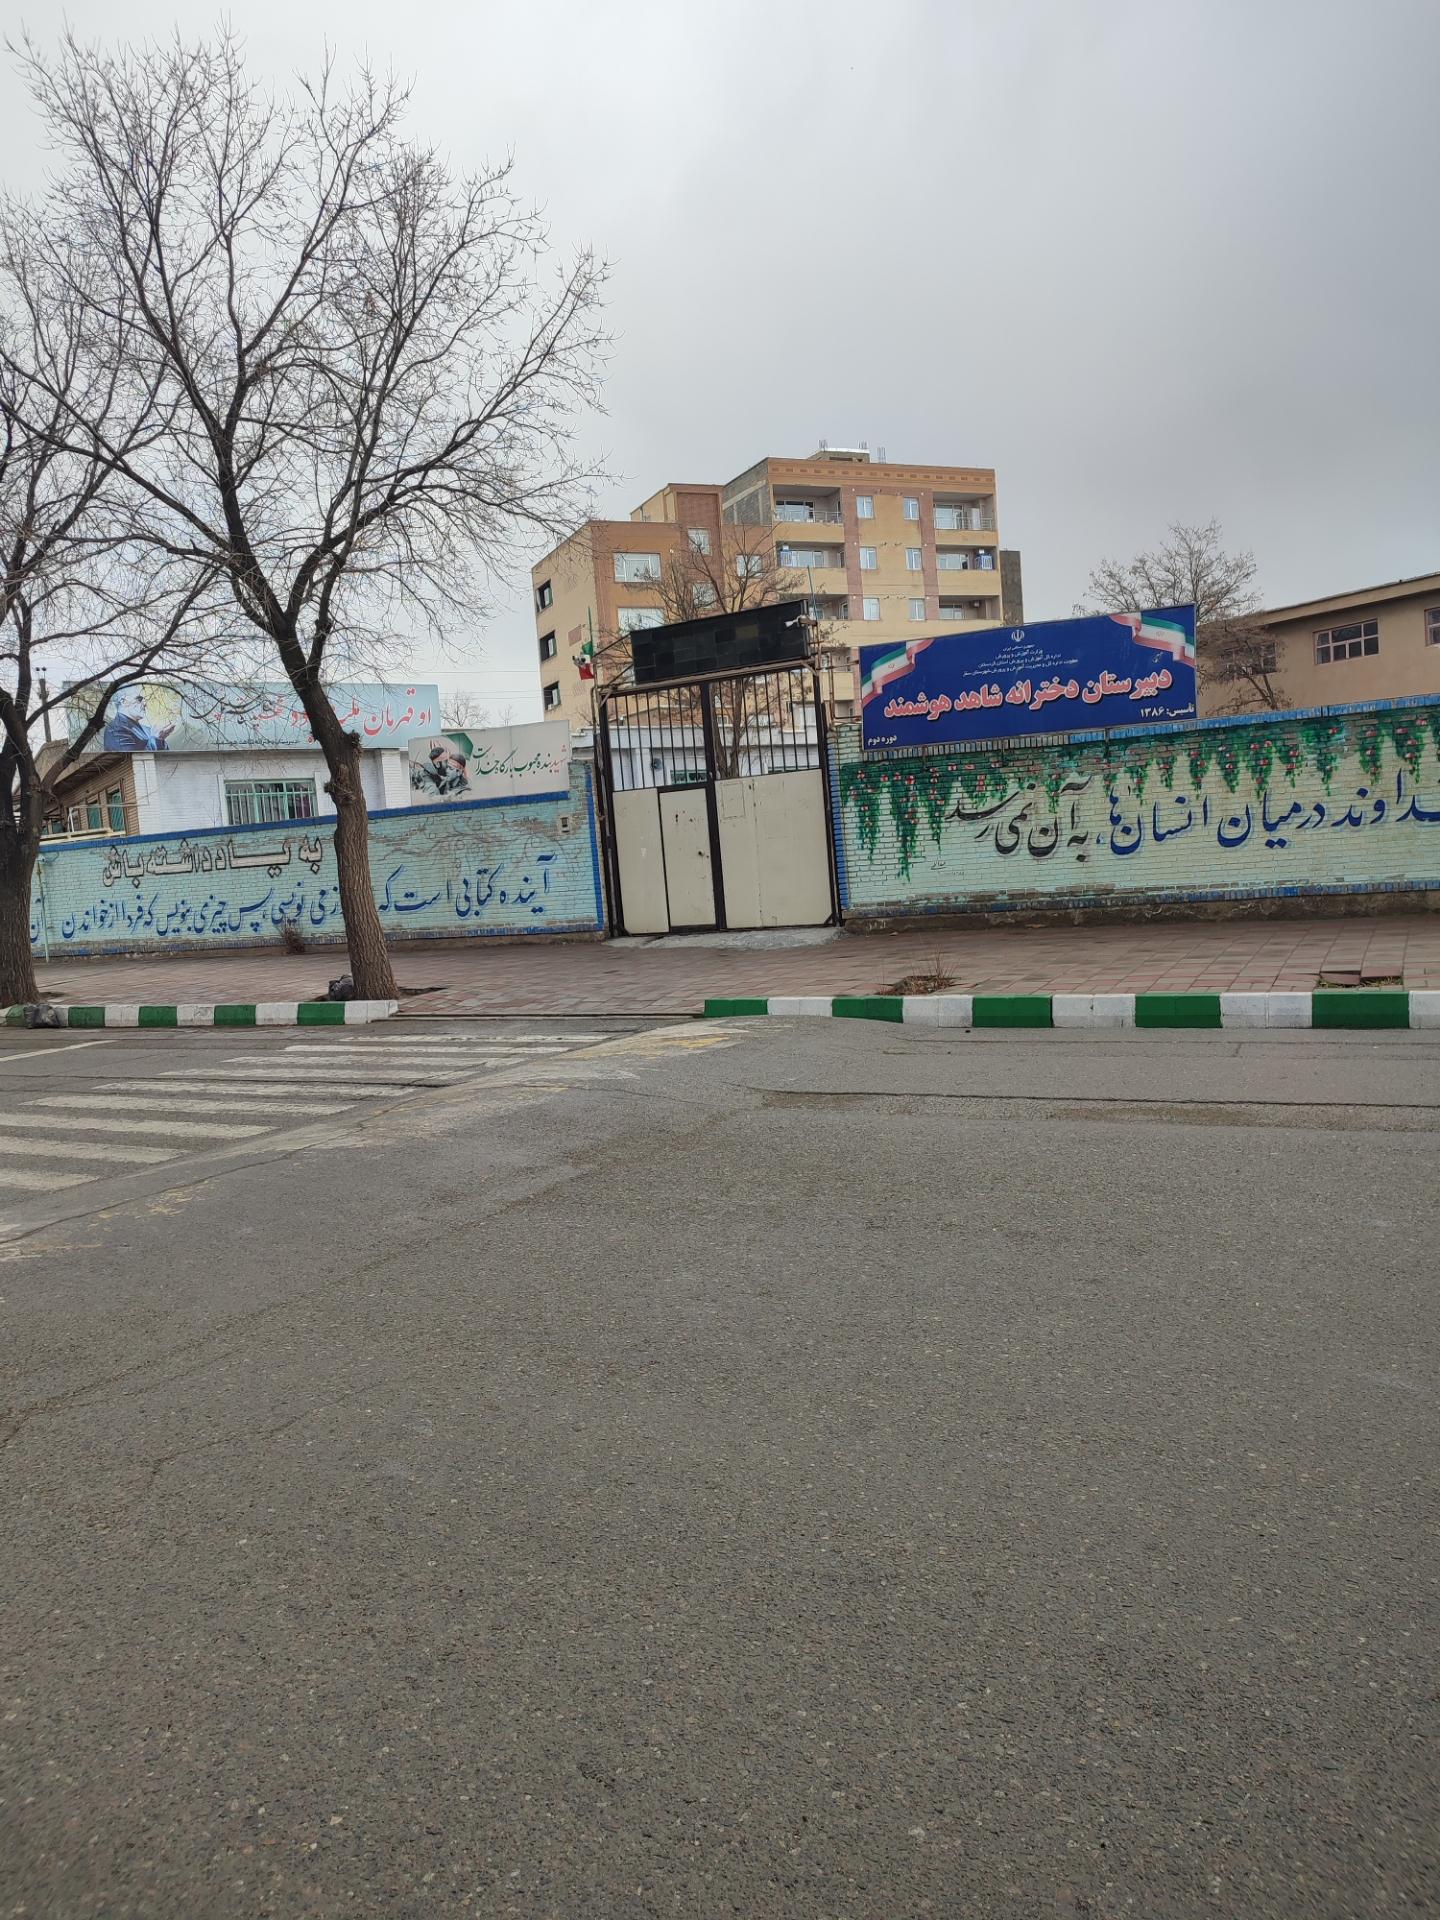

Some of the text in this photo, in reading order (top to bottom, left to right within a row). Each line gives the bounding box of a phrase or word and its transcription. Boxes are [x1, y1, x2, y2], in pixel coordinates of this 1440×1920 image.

[363, 687, 416, 736] قهرمان
[884, 669, 1172, 721] دبیرستان دخترانه شاهد هوشمند
[1141, 706, 1165, 718] ۱۳۸۶
[868, 735, 897, 746] دوره دوم
[1217, 791, 1302, 849] میان
[1296, 802, 1326, 829] در
[1331, 767, 1440, 827] داوند
[102, 834, 323, 888] به یاد داشته باش
[499, 852, 557, 914] آینده
[142, 892, 159, 928] که
[378, 864, 403, 912] که
[394, 878, 450, 912] است
[455, 863, 504, 917] کتابی
[122, 894, 144, 934] فردا
[193, 894, 227, 934] چیزی
